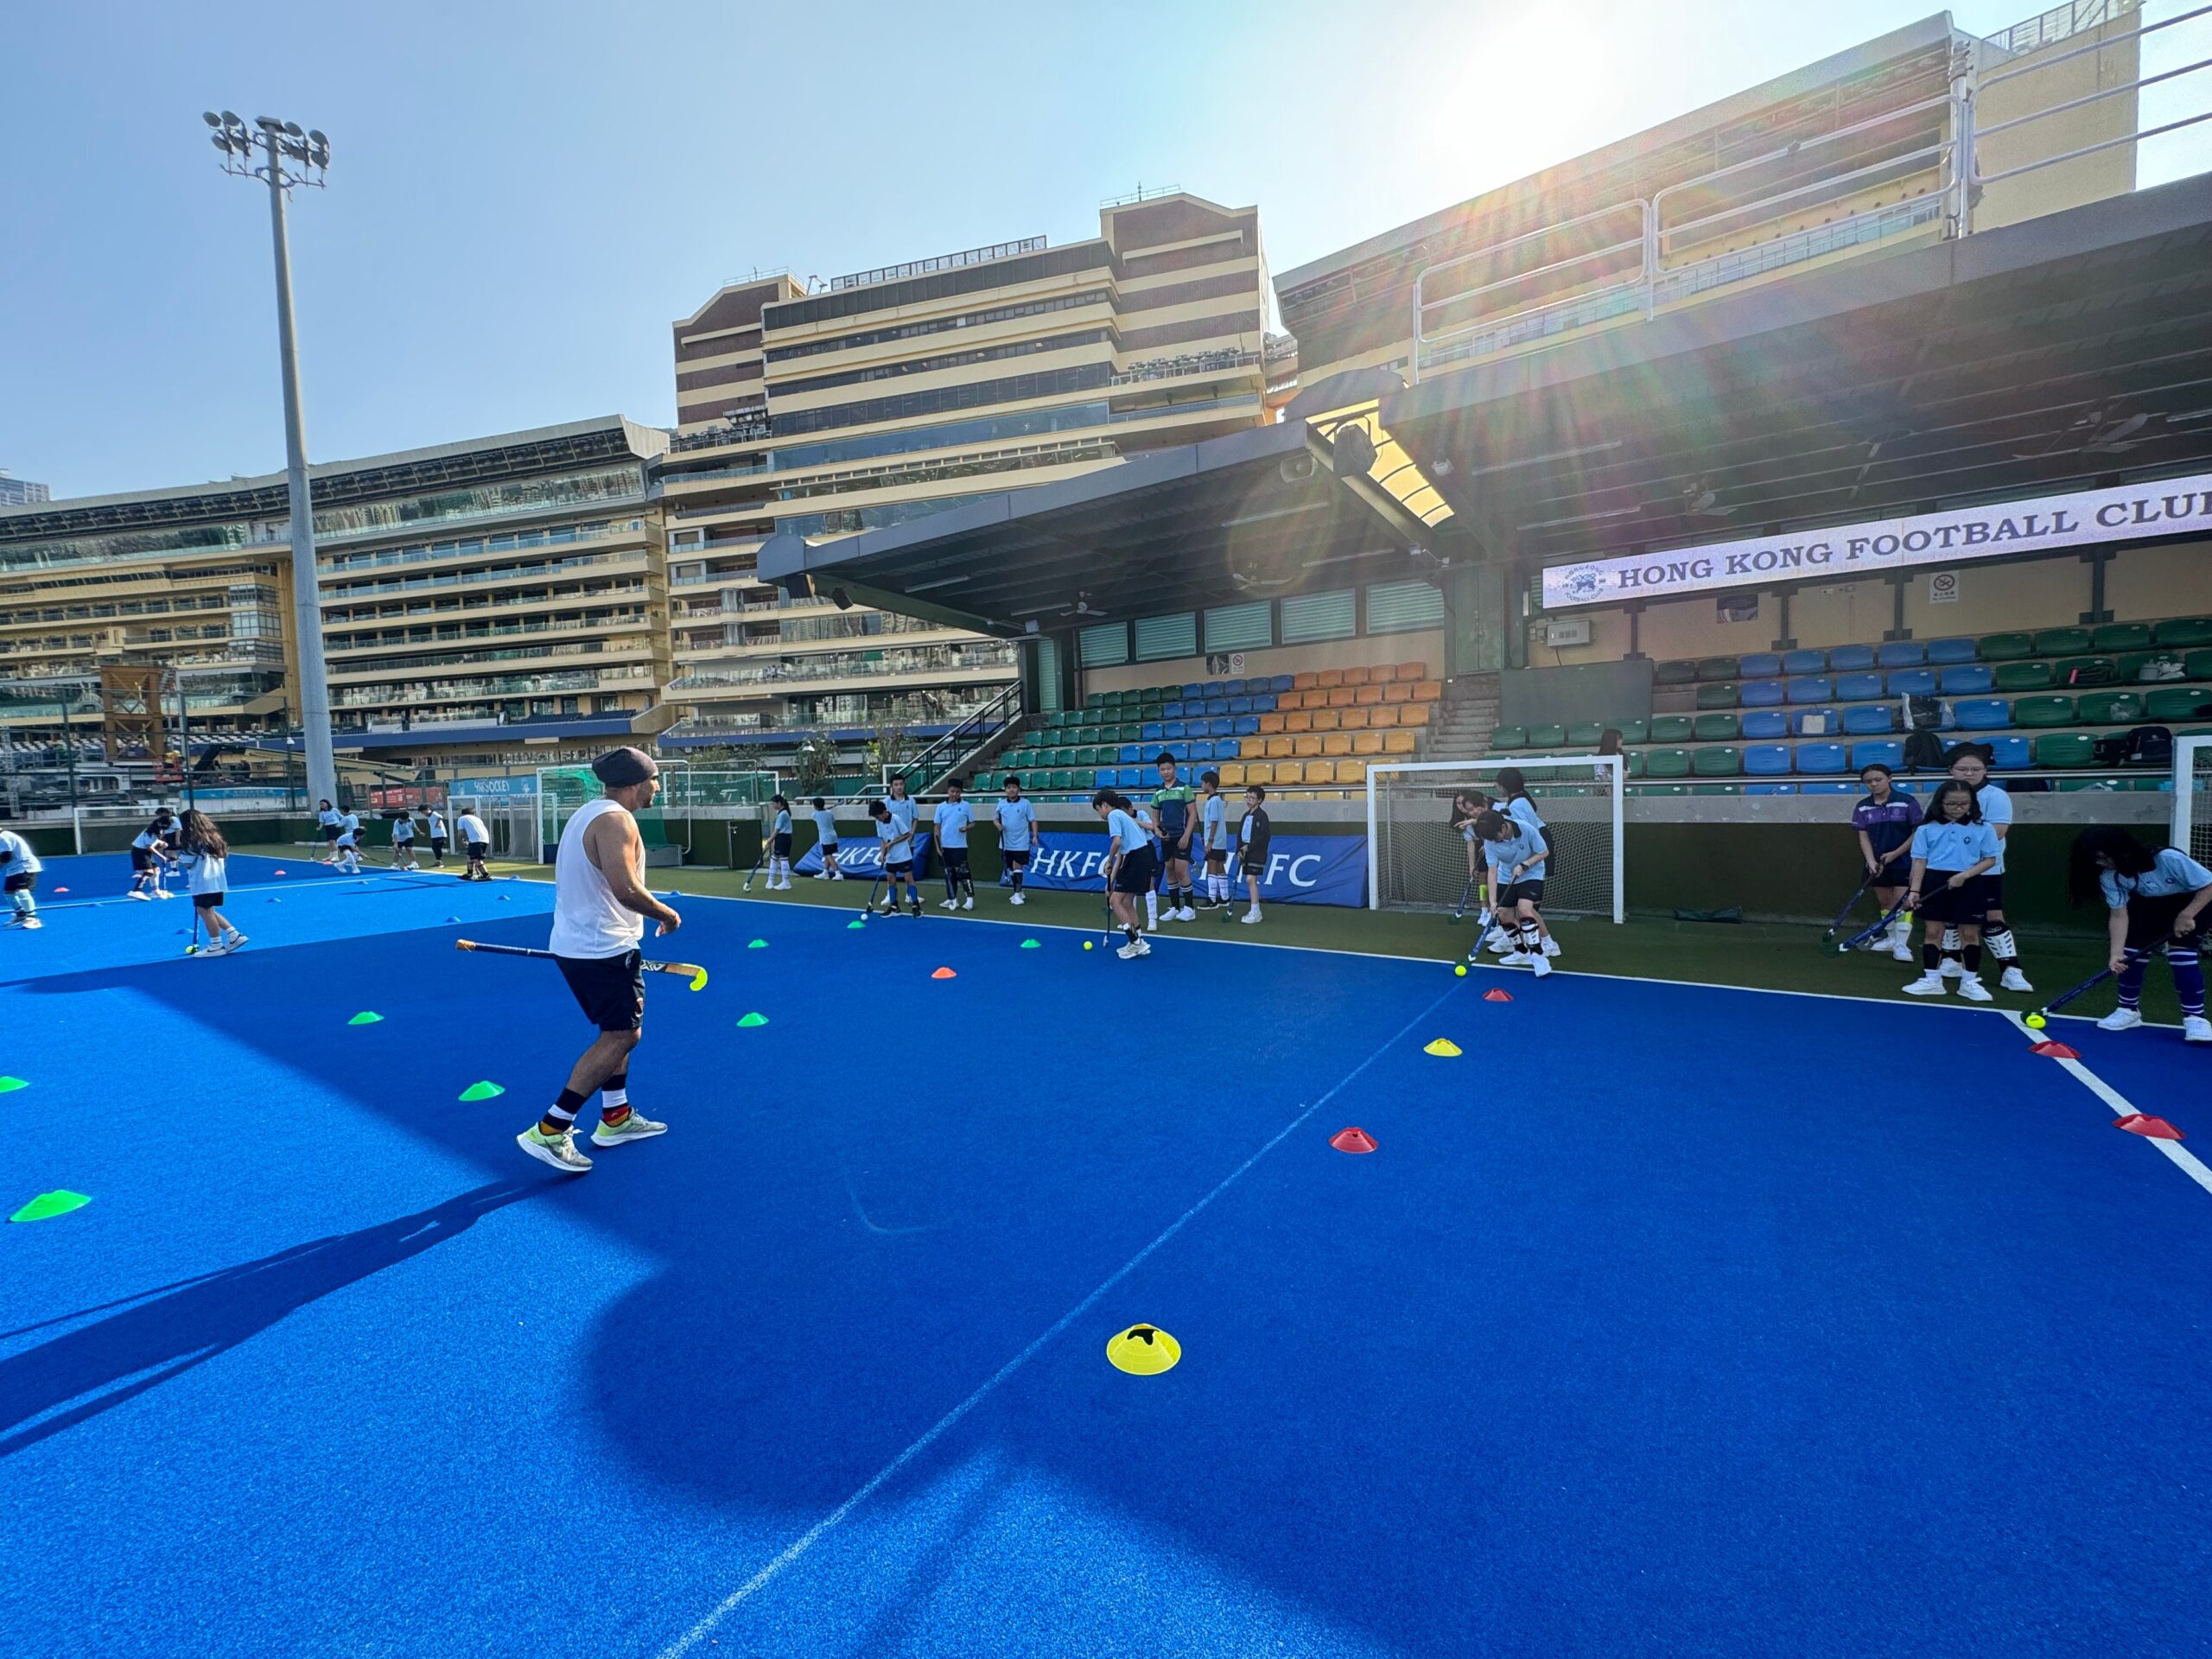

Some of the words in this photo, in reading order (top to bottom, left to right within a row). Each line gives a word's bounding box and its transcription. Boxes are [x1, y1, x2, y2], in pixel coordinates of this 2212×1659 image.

[1618, 558, 1714, 589] HONG
[1725, 543, 1834, 575] KONG
[1846, 510, 2080, 561] FOOTBALL
